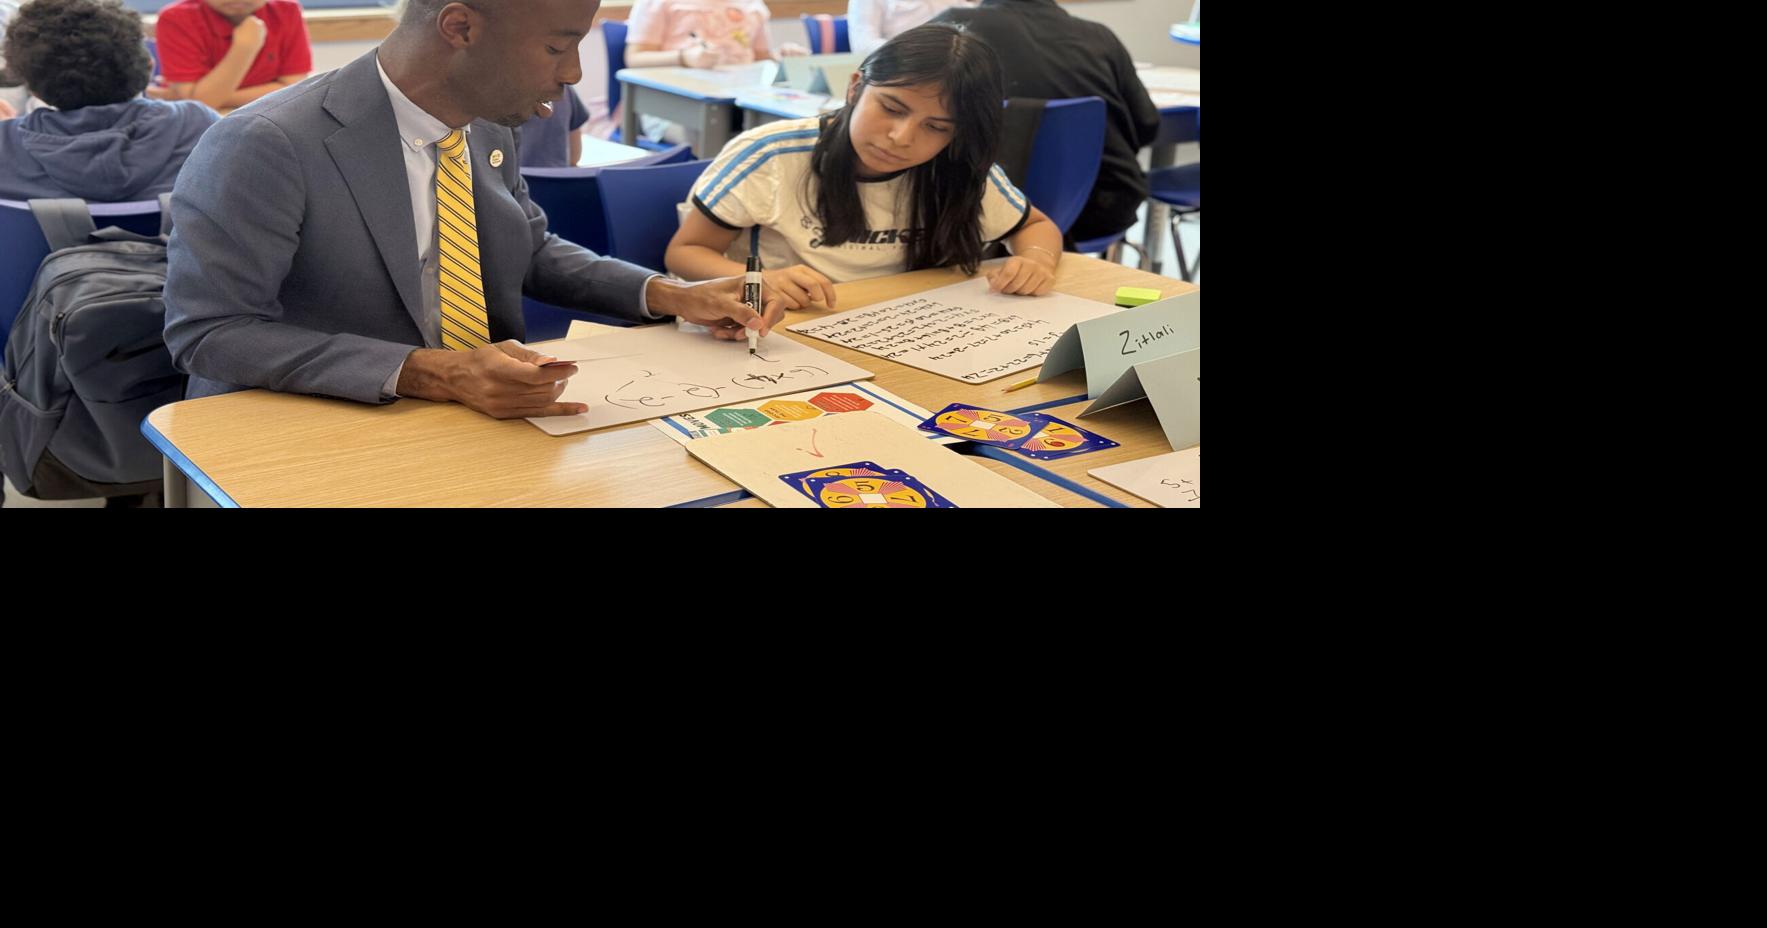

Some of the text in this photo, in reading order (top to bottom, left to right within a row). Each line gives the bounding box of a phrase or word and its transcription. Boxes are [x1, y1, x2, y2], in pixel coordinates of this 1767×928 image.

[1119, 324, 1175, 355] Zitlali
[983, 413, 1004, 422] 5
[855, 481, 875, 492] 5
